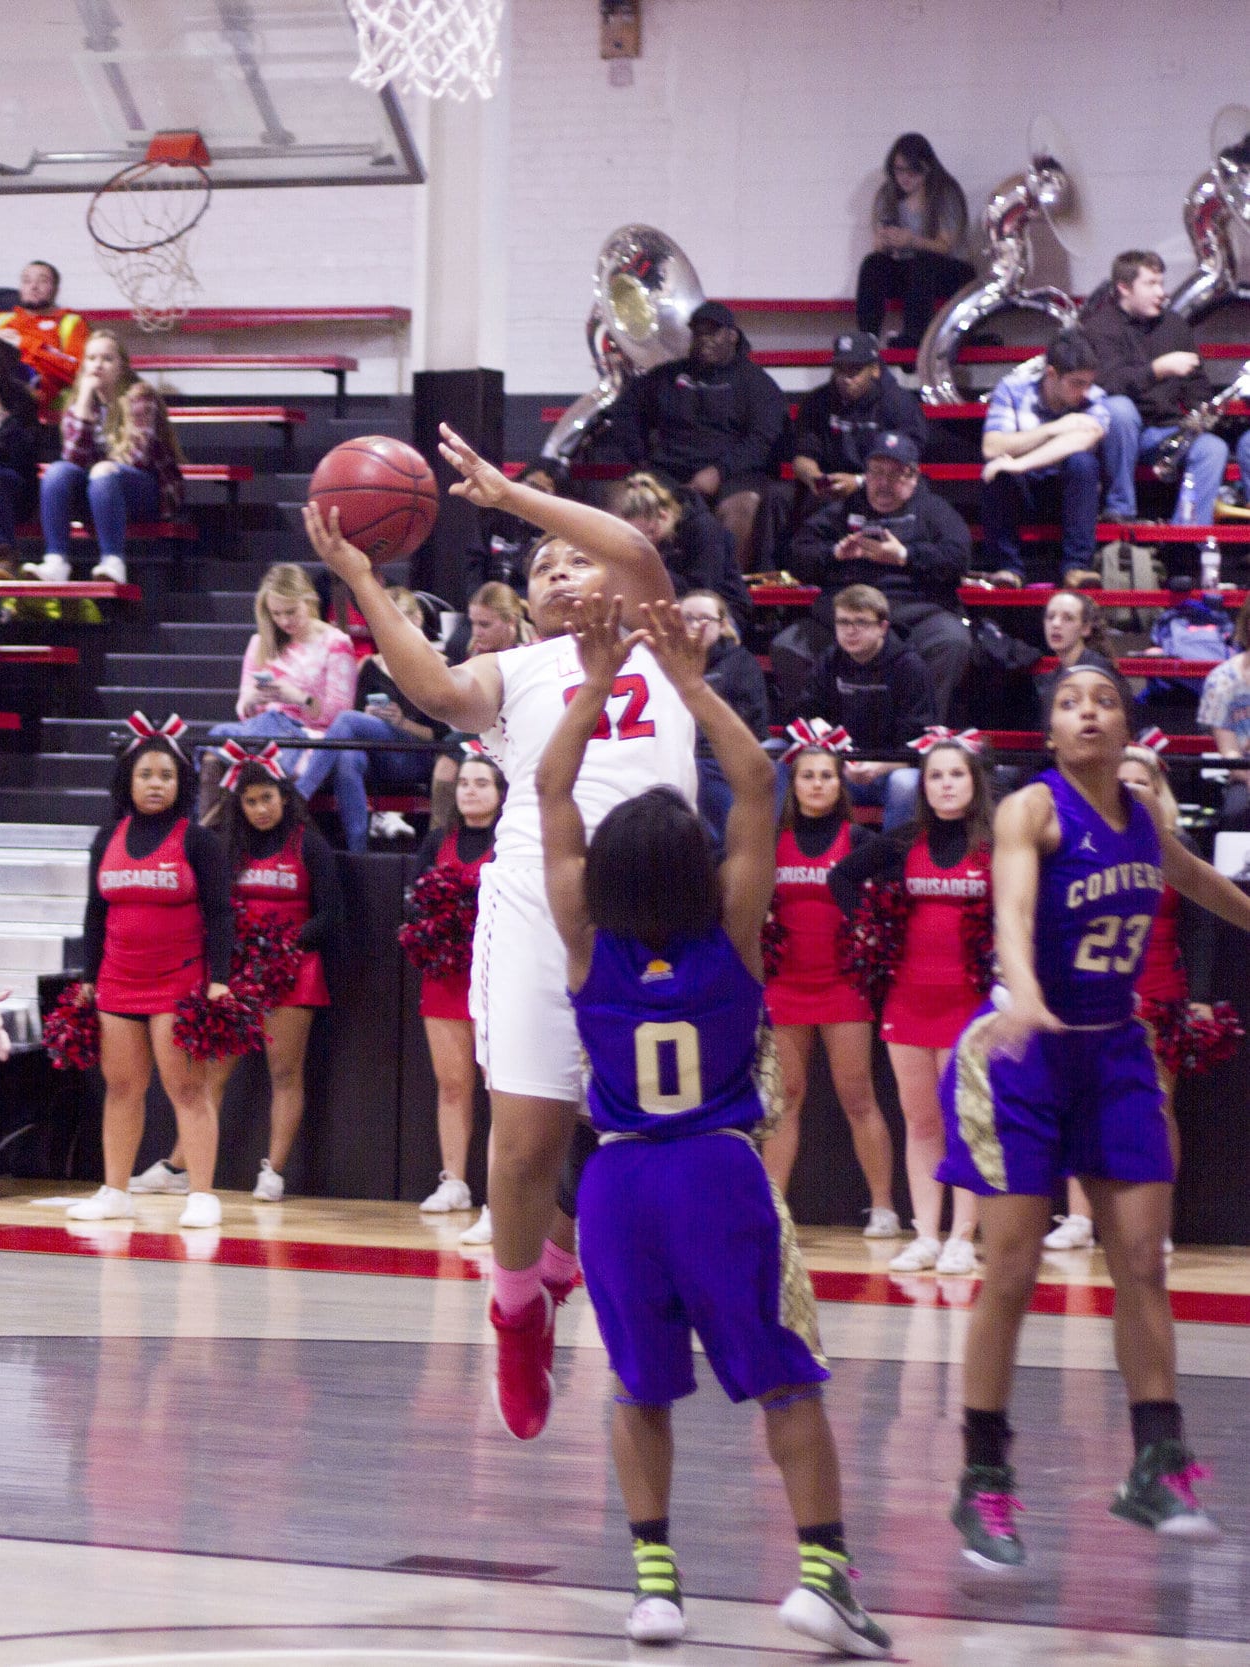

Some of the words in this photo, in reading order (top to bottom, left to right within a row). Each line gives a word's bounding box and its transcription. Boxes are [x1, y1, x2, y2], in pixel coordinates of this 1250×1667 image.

[100, 870, 178, 890] CRUSADERS
[906, 876, 987, 897] CRUSADERS
[1074, 914, 1152, 974] 23
[635, 1021, 702, 1115] 0
